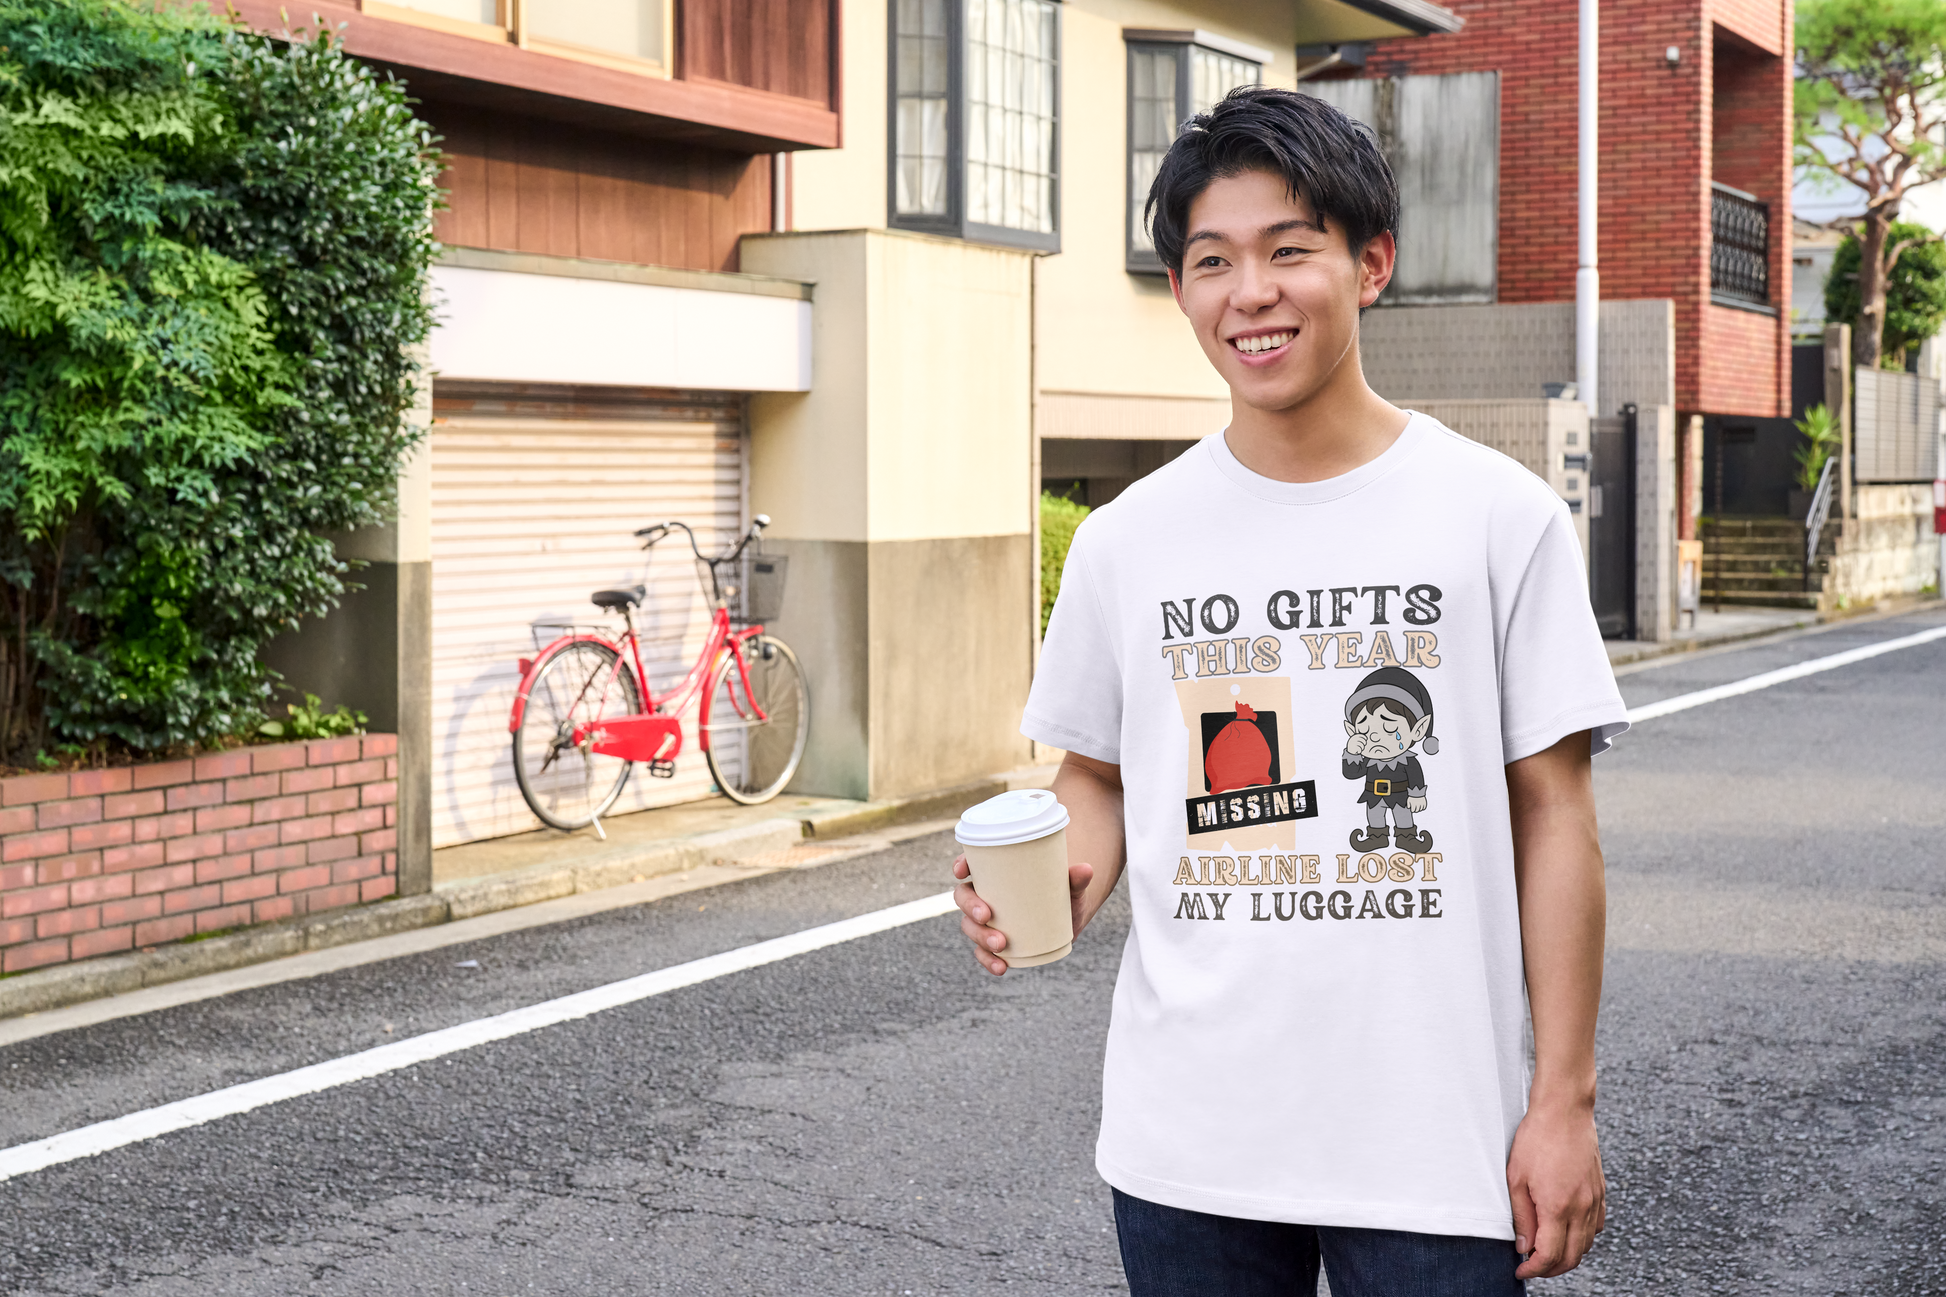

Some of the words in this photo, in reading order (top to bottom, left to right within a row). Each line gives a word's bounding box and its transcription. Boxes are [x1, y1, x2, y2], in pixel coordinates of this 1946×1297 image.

[1161, 593, 1240, 640] NO
[1267, 584, 1443, 630] GIFTS
[1162, 635, 1281, 680] THIS
[1300, 630, 1442, 670] YEAR
[1196, 788, 1307, 828] MISSING
[1173, 855, 1321, 886] AIRLINE
[1335, 852, 1443, 883] LOST
[1173, 892, 1232, 920] MY
[1250, 888, 1443, 921] LUGGAGE
